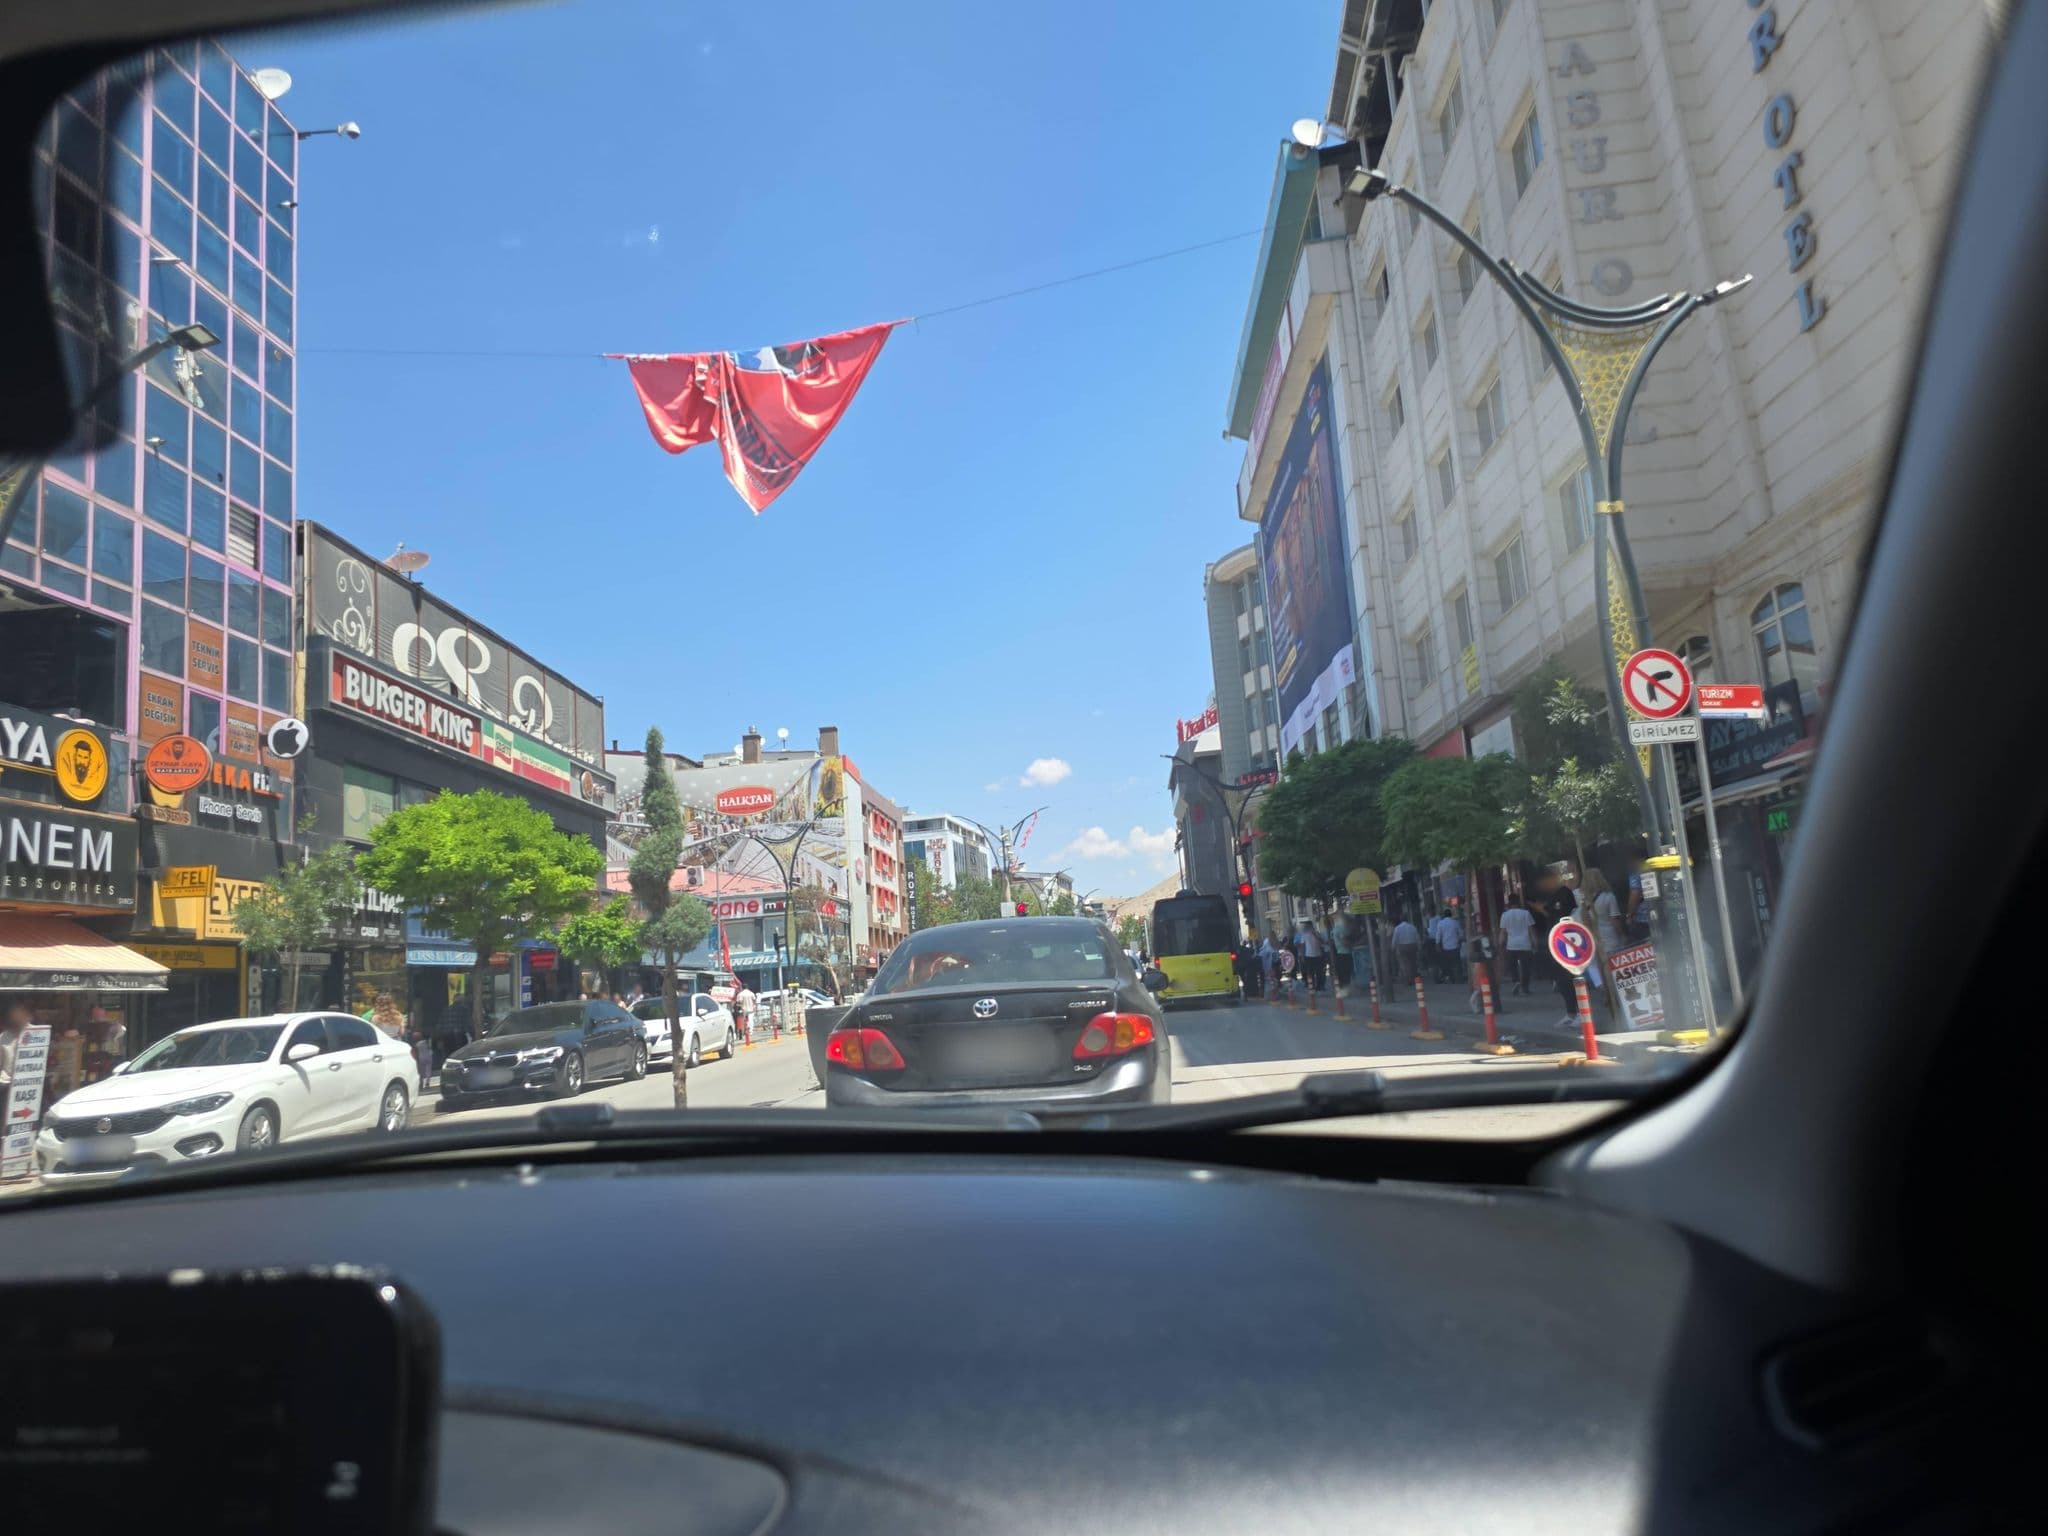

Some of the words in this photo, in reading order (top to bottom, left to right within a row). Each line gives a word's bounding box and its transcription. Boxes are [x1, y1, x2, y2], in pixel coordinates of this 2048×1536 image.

[343, 664, 427, 730] BURGER
[431, 707, 474, 746] KING
[199, 795, 233, 818] iPhone
[719, 793, 773, 807] HALKTAN
[0, 818, 113, 873] NEM
[1610, 945, 1655, 968] VATAN
